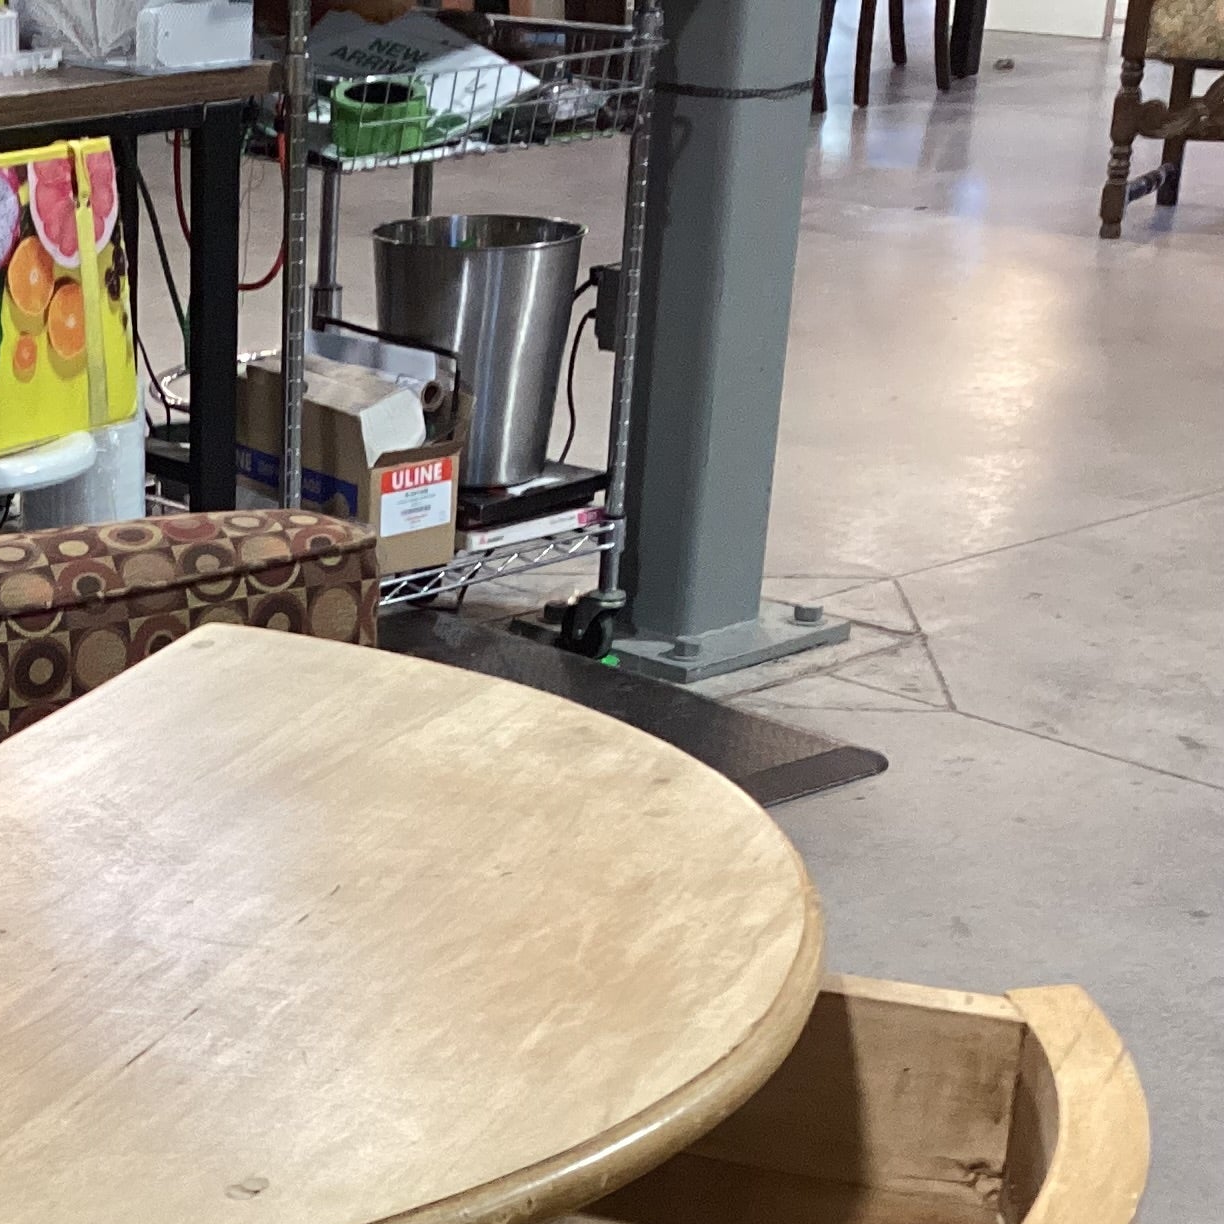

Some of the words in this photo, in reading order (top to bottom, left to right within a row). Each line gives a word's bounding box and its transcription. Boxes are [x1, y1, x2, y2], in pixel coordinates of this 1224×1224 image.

[329, 45, 414, 73] ARRIV
[368, 37, 429, 63] NEW
[391, 462, 443, 490] ULINE
